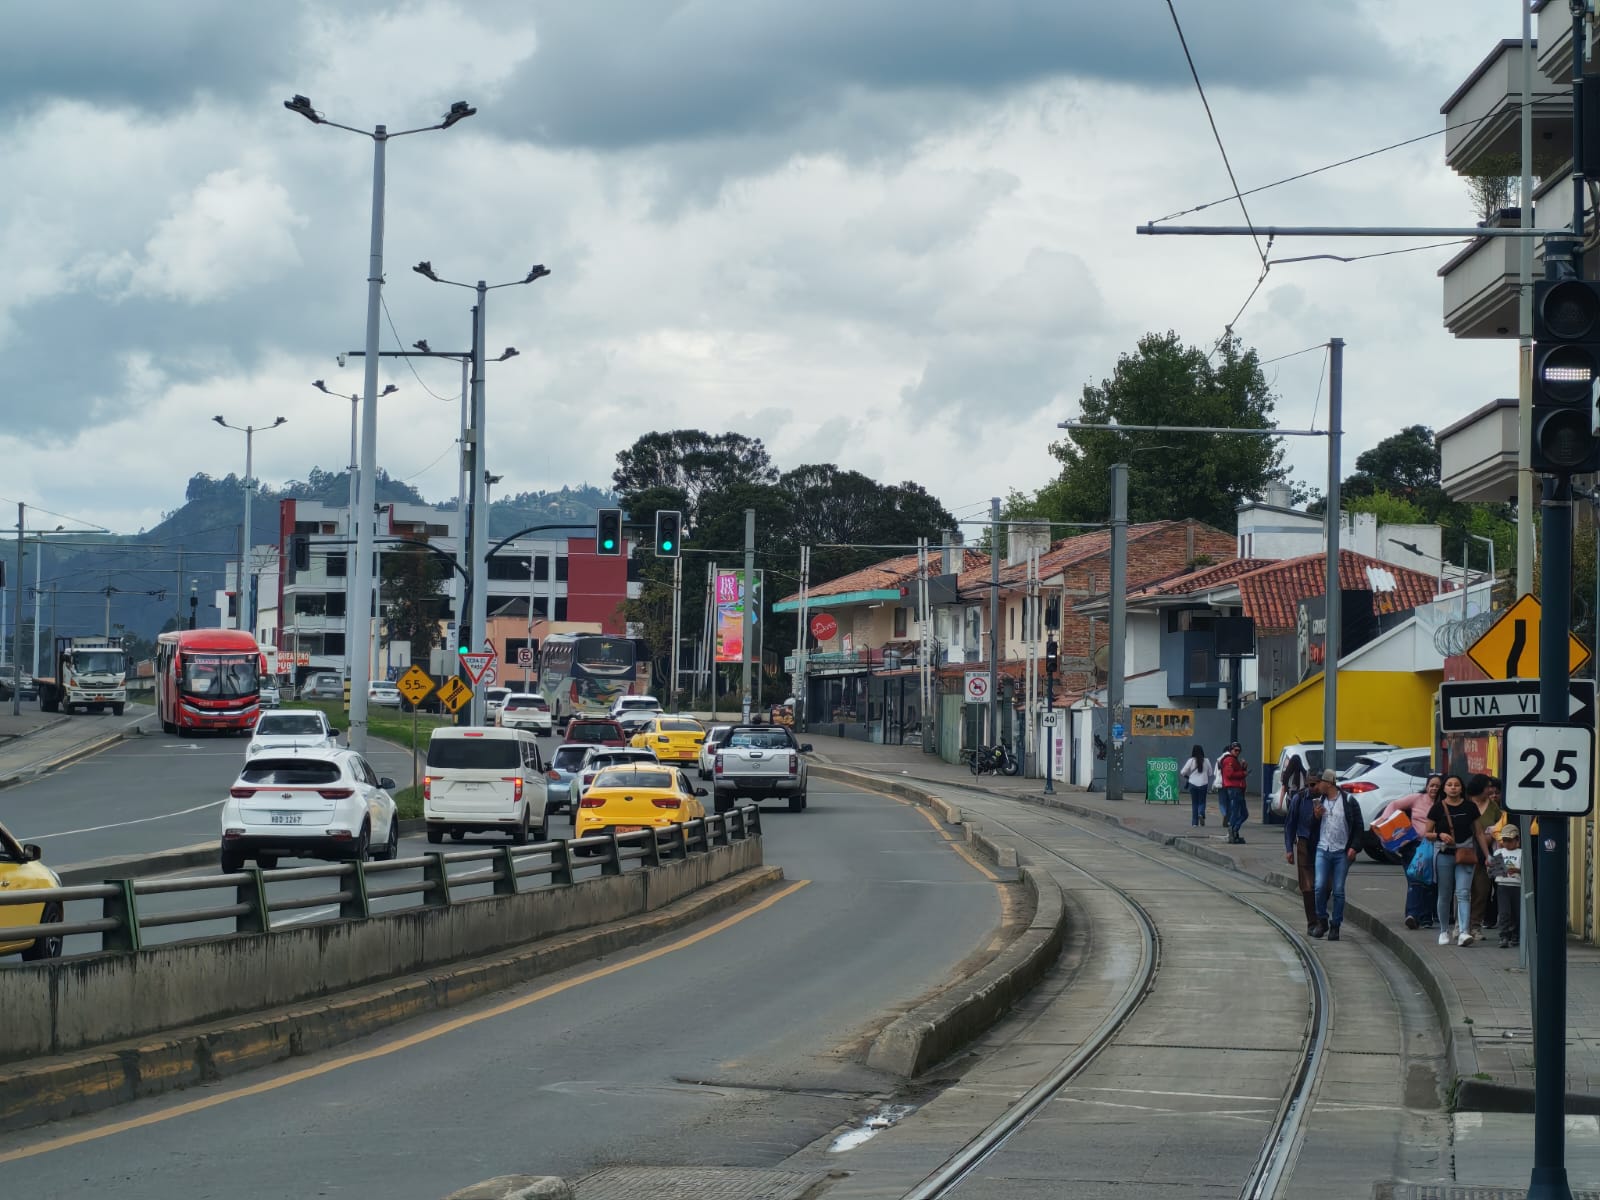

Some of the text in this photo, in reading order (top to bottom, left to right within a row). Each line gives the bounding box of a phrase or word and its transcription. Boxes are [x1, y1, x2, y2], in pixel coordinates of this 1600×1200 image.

[1458, 694, 1537, 715] UNA VI
[1043, 715, 1055, 723] 40
[1147, 760, 1178, 772] TODO
[1518, 747, 1578, 791] 25
[1159, 772, 1168, 785] X
[1155, 784, 1172, 799] $1
